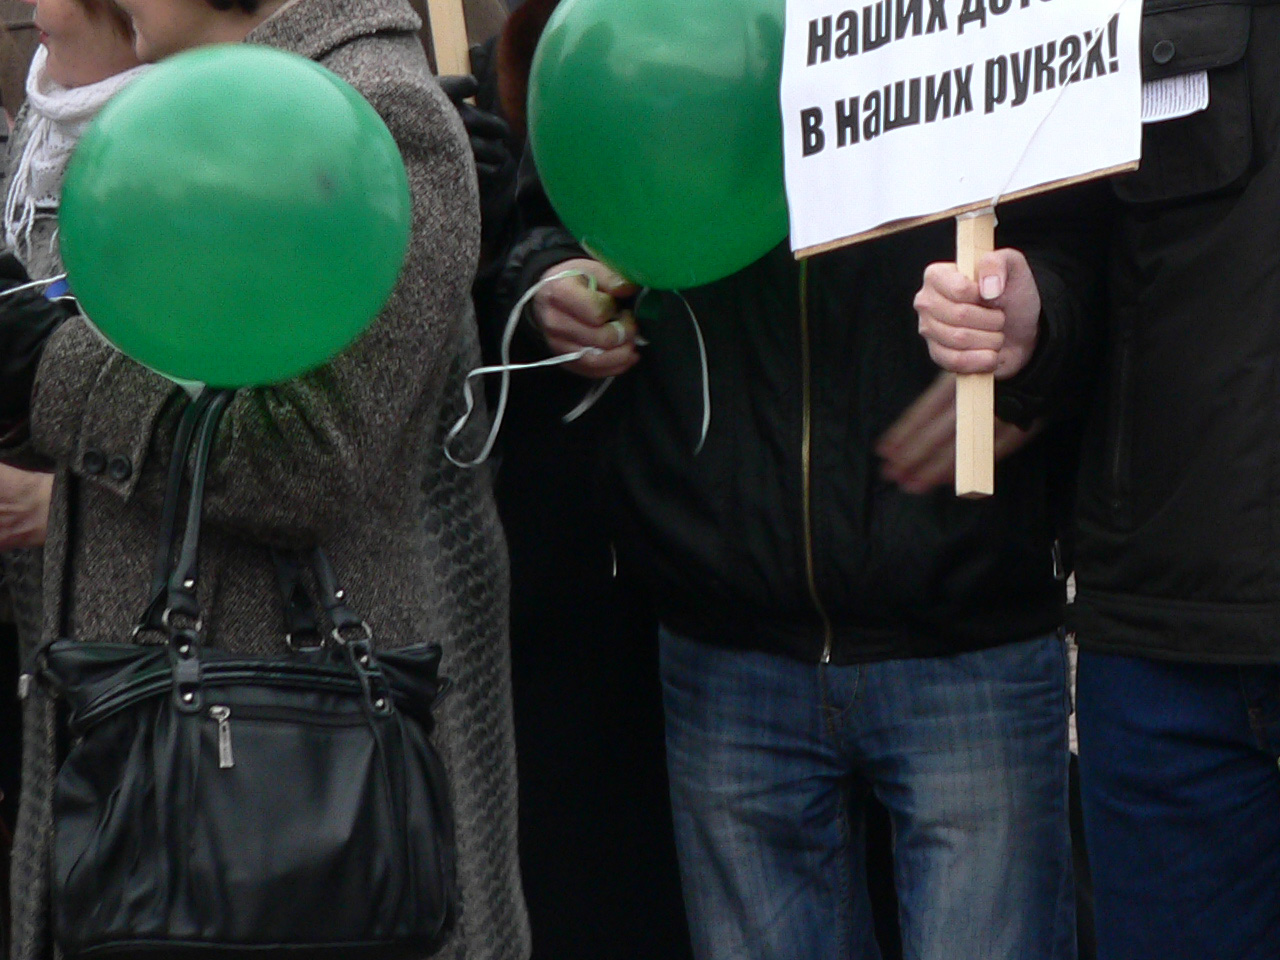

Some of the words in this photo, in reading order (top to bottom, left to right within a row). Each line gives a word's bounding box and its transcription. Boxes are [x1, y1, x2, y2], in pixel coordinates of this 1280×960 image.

[800, 105, 824, 158] в
[835, 63, 974, 149] наших
[984, 12, 1120, 115] руках!
